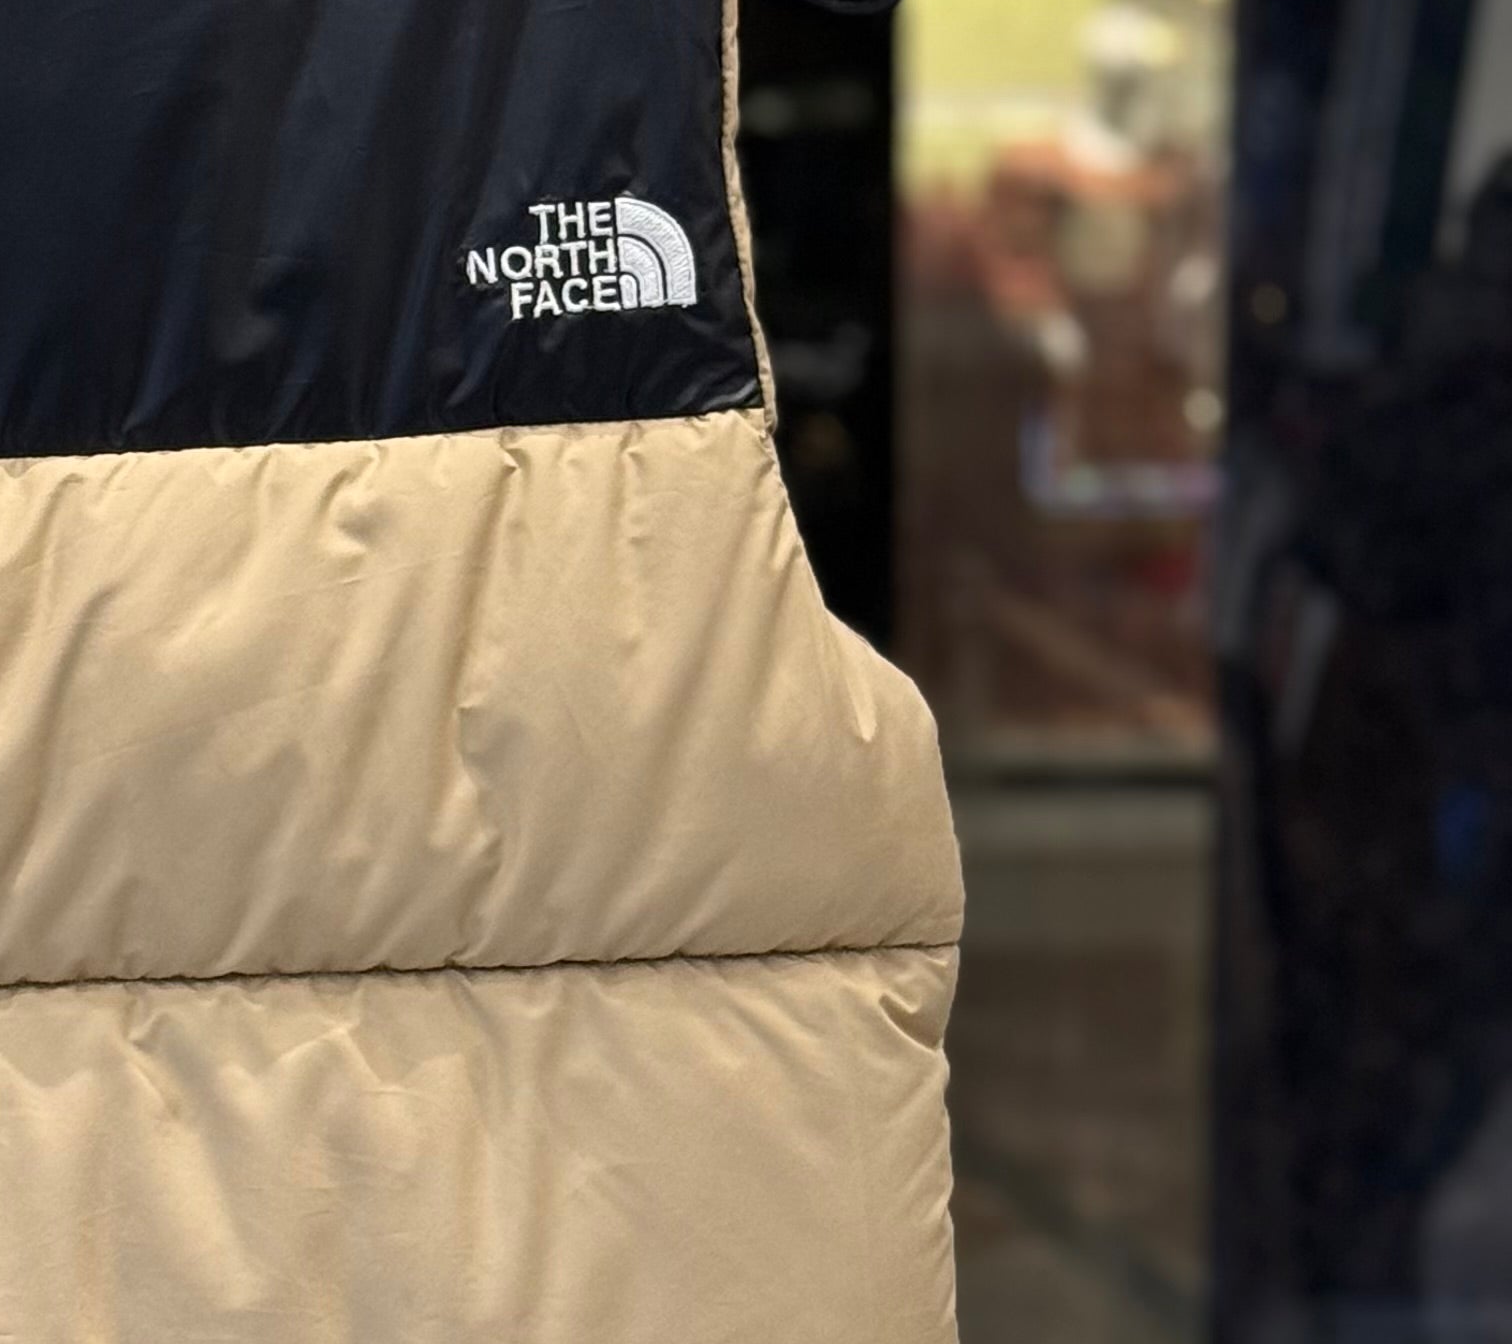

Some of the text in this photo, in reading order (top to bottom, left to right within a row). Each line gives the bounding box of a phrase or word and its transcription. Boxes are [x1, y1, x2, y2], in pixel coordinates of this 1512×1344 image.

[529, 202, 615, 244] THE
[466, 239, 617, 285] NORTH
[511, 275, 620, 320] FACE
